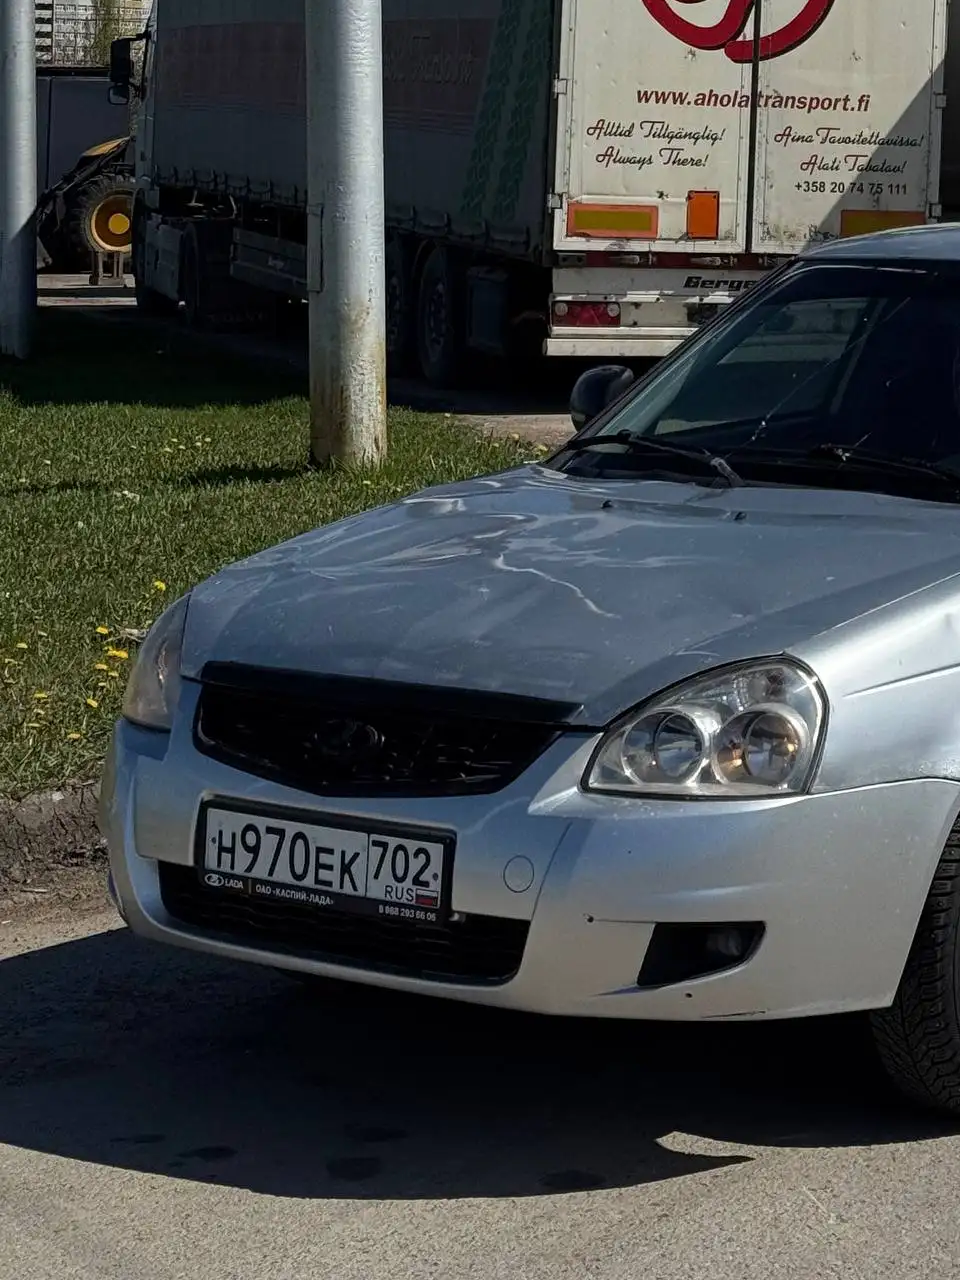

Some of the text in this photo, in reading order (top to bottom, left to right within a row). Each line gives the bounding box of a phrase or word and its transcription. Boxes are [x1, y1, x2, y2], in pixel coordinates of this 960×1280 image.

[586, 119, 726, 146] Alltid Tillgänglig!
[774, 125, 814, 147] Aina
[595, 146, 709, 170] Always There!
[795, 181, 826, 193] +358
[830, 181, 845, 193] 20
[850, 182, 865, 194] 74
[888, 183, 907, 195] 111
[683, 276, 759, 291] Berge
[371, 839, 431, 888] 702
[225, 879, 244, 889] LADA
[385, 885, 414, 902] RUS
